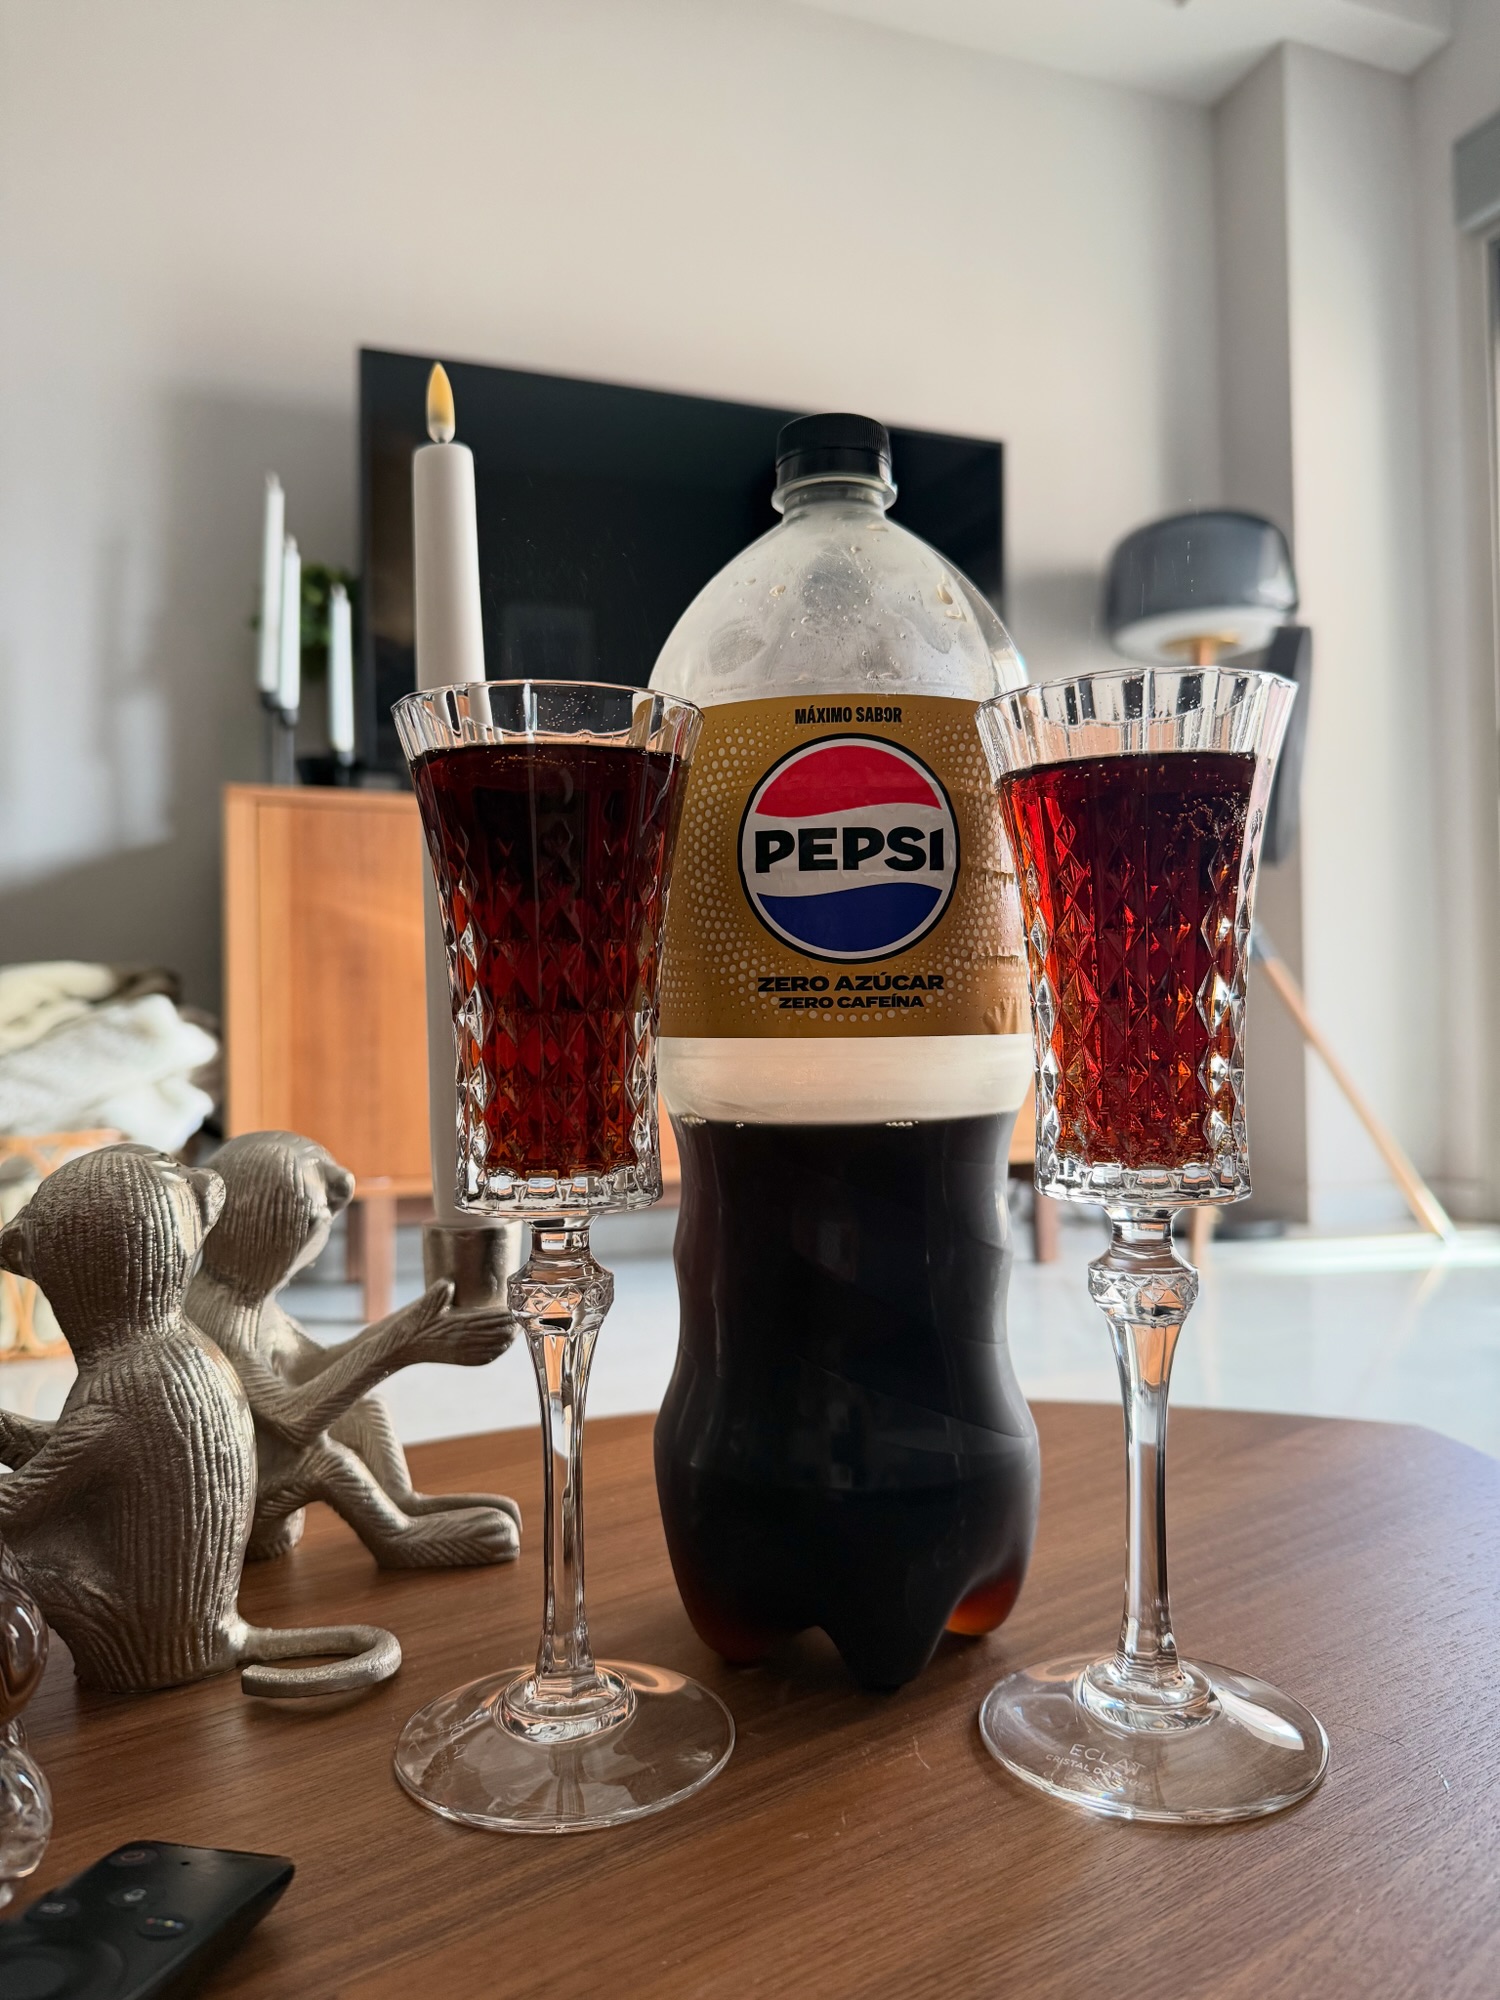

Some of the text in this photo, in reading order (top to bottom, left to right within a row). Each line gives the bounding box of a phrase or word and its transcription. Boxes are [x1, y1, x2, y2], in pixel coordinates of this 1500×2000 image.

[795, 705, 902, 724] MÁXIMO SABOR
[755, 826, 944, 873] PEPSI
[758, 972, 945, 992] ZERO AZÚCAR
[779, 993, 924, 1008] ZERO CAFEÍNA
[1045, 1754, 1090, 1773] CRISTAL
